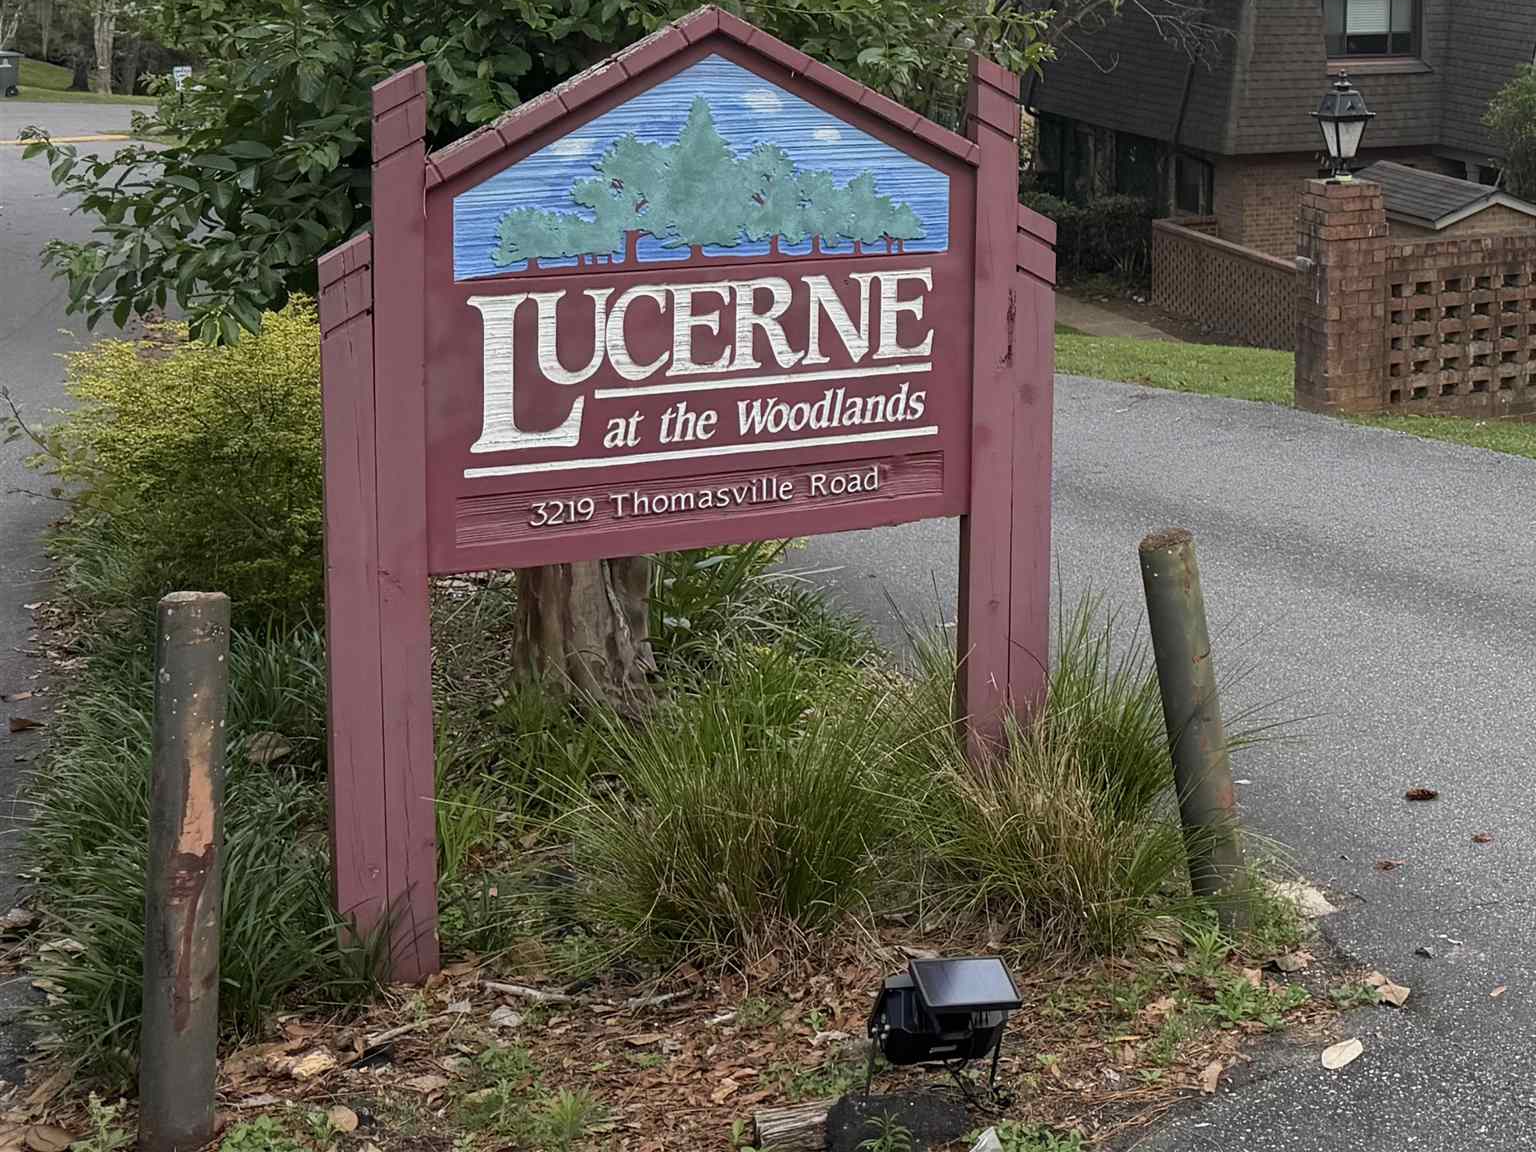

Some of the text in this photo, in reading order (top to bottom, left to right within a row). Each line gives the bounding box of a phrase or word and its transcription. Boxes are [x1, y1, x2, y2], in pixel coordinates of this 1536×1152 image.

[466, 266, 936, 454] LUCERNE
[603, 382, 926, 449] at the Woodlands
[529, 465, 880, 528] 3219 Thomasville Road
